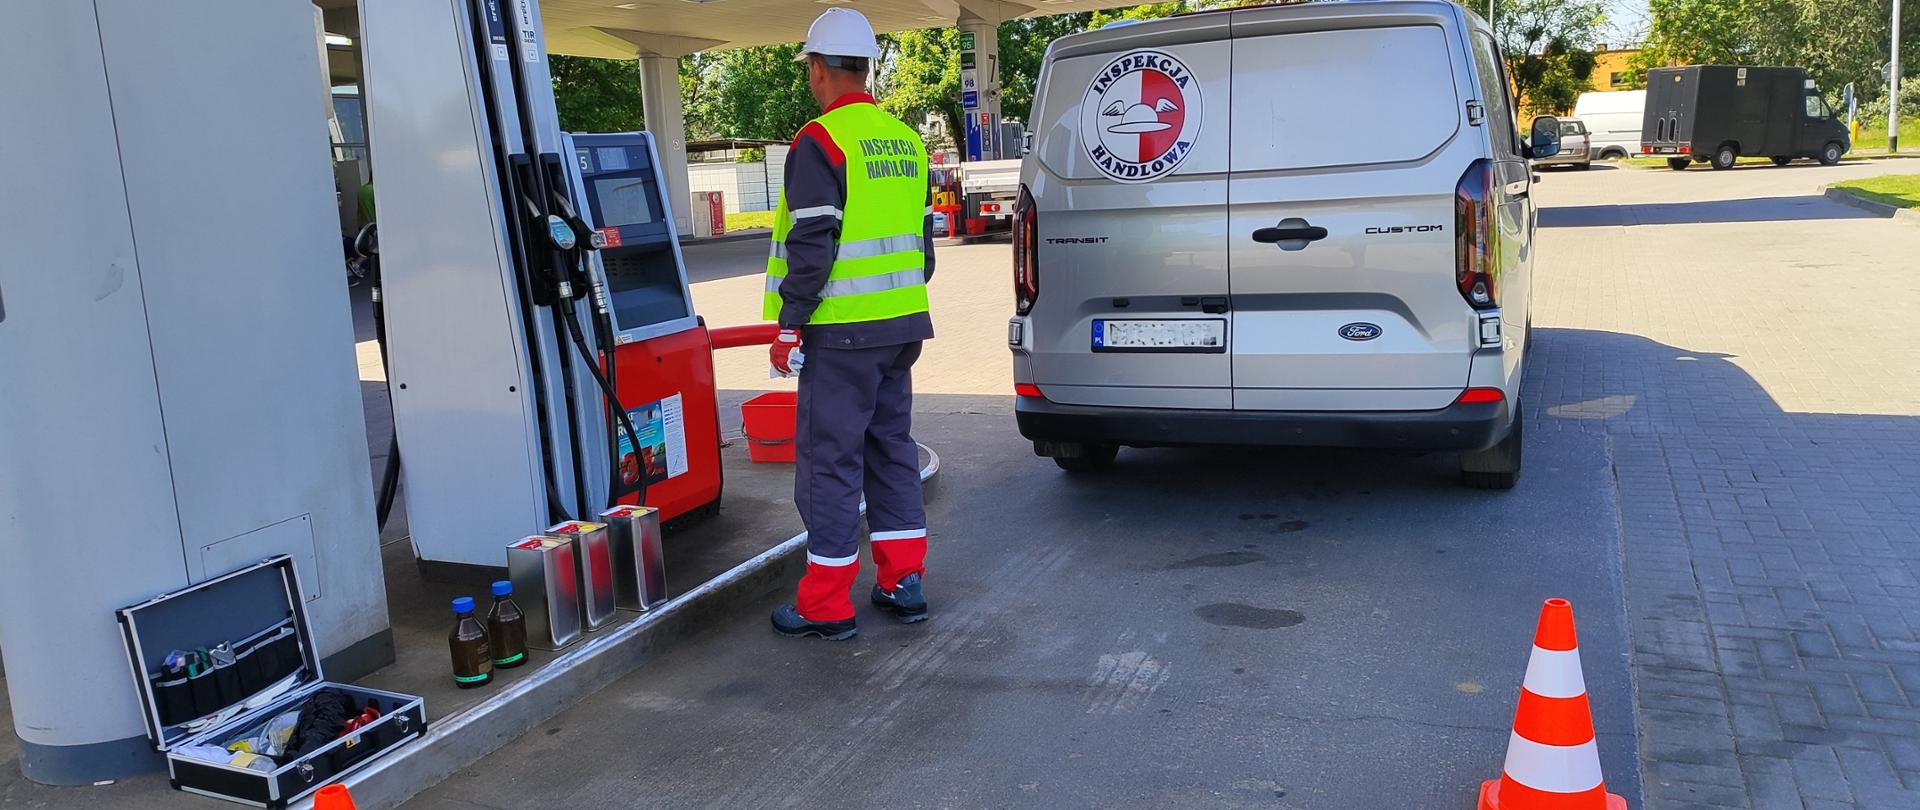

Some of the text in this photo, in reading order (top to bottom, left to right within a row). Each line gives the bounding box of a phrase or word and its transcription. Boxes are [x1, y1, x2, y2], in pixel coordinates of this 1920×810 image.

[522, 30, 535, 39] TIR
[961, 41, 972, 50] 95
[1093, 55, 1189, 95] INSPEKCJA
[964, 79, 975, 88] 98
[580, 156, 588, 170] 5
[1091, 140, 1190, 177] HANDLOWA
[1365, 224, 1443, 235] CUSTOM
[1046, 236, 1109, 244] TRANSIT
[1346, 326, 1373, 337] Ford
